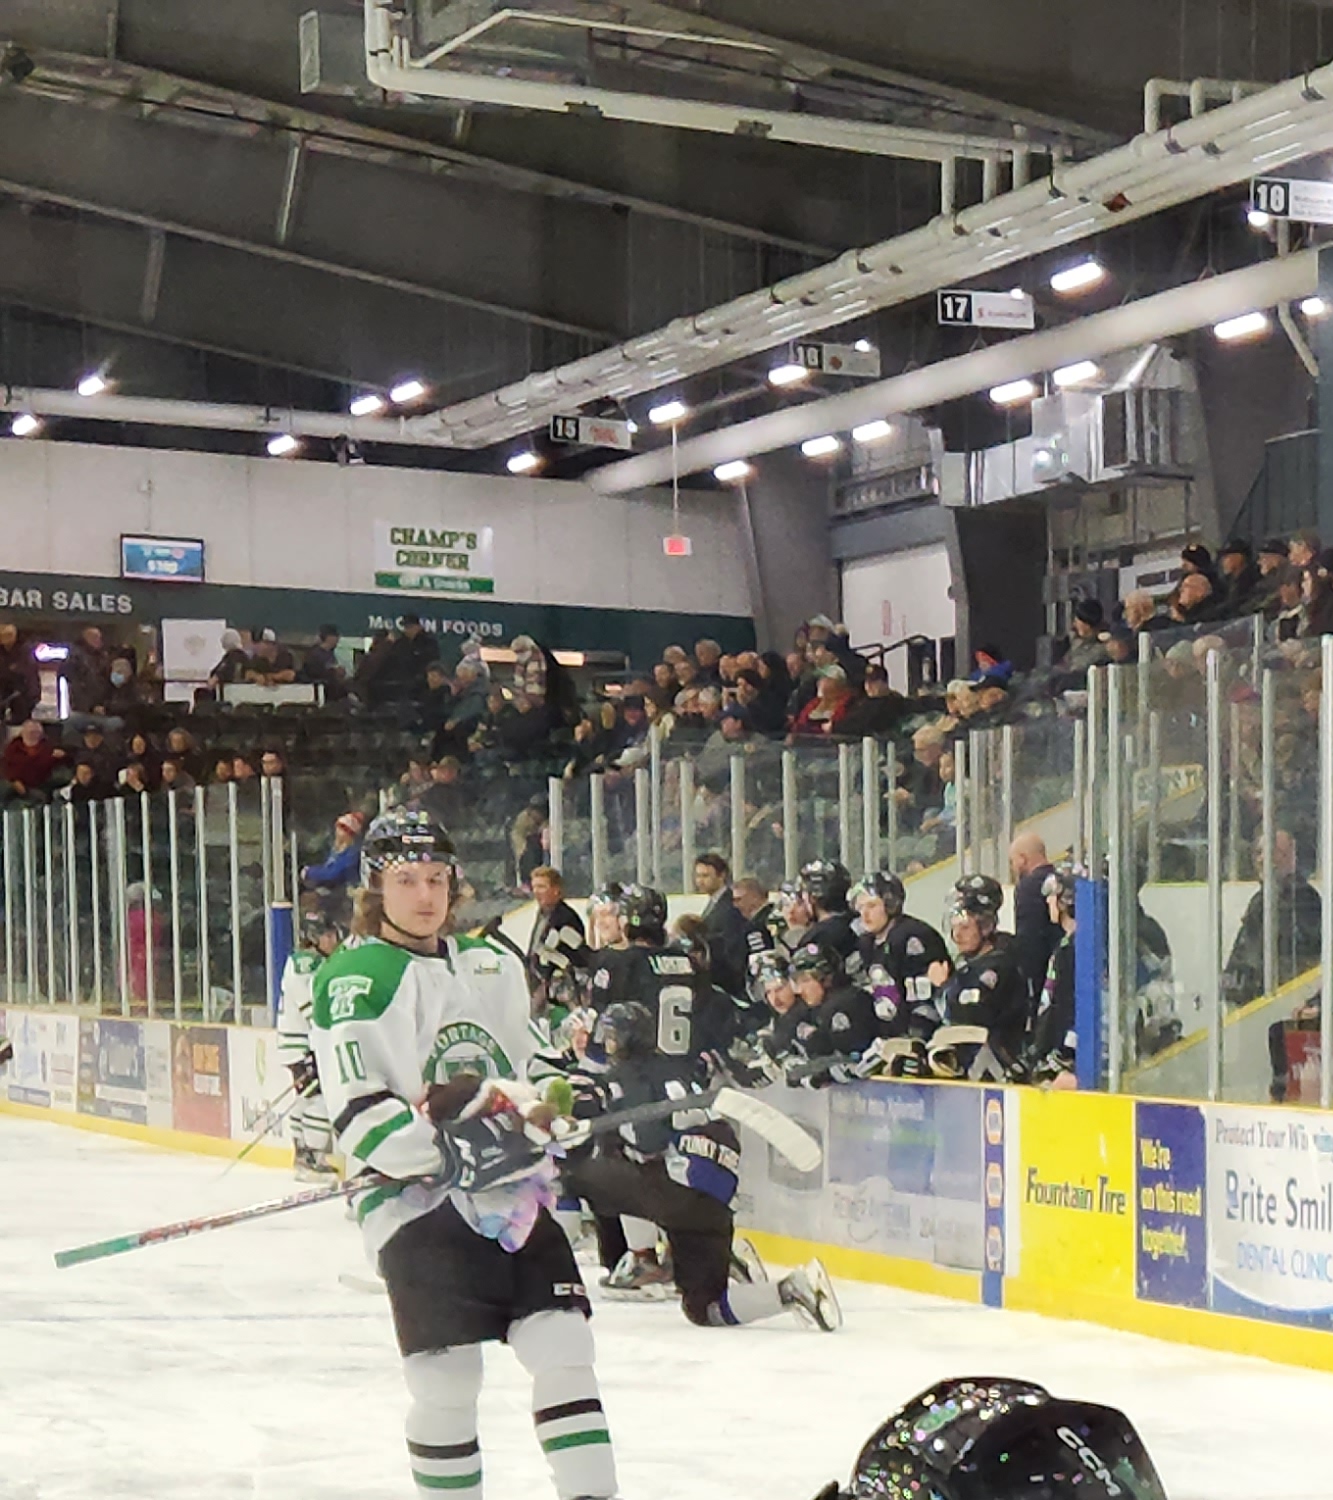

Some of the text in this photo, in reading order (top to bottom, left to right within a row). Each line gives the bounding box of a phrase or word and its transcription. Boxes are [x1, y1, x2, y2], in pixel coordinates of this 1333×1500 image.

[943, 295, 969, 319] 17
[555, 417, 577, 439] 15
[52, 590, 133, 614] SALES
[442, 619, 503, 637] FOODS
[657, 985, 693, 1056] 6
[1026, 1167, 1126, 1215] Fountain Tire
[1225, 1169, 1277, 1226] Brite
[1237, 1241, 1333, 1284] DENTAL CLINIC
[1056, 1425, 1121, 1497] CCM
